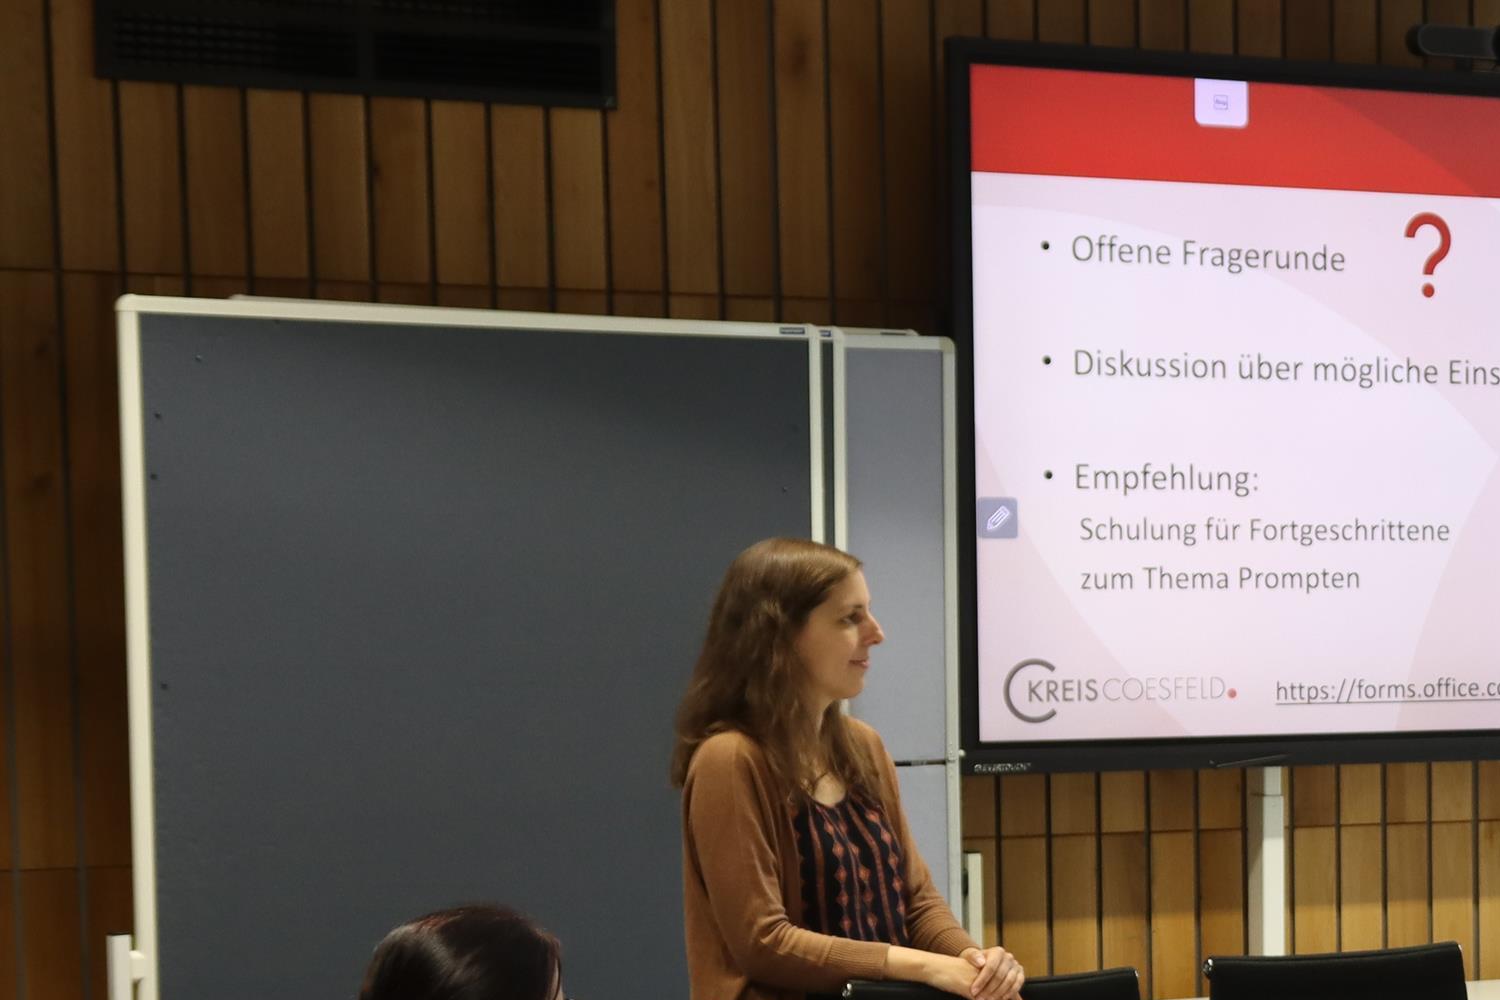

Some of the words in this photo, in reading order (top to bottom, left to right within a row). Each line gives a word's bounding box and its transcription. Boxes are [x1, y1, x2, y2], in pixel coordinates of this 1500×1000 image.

[1072, 234, 1172, 265] Offene
[1183, 239, 1346, 274] Fragerunde
[1074, 349, 1227, 379] Diskussion
[1238, 353, 1304, 381] über
[1313, 356, 1439, 389] mögliche
[1075, 462, 1258, 498] Empfehlung:
[1080, 516, 1197, 547] Schulung
[1205, 516, 1241, 541] für
[1250, 517, 1450, 547] Fortgeschrittene
[1080, 572, 1134, 590] zum
[1142, 566, 1229, 590] Thema
[1239, 566, 1360, 595] Prompten
